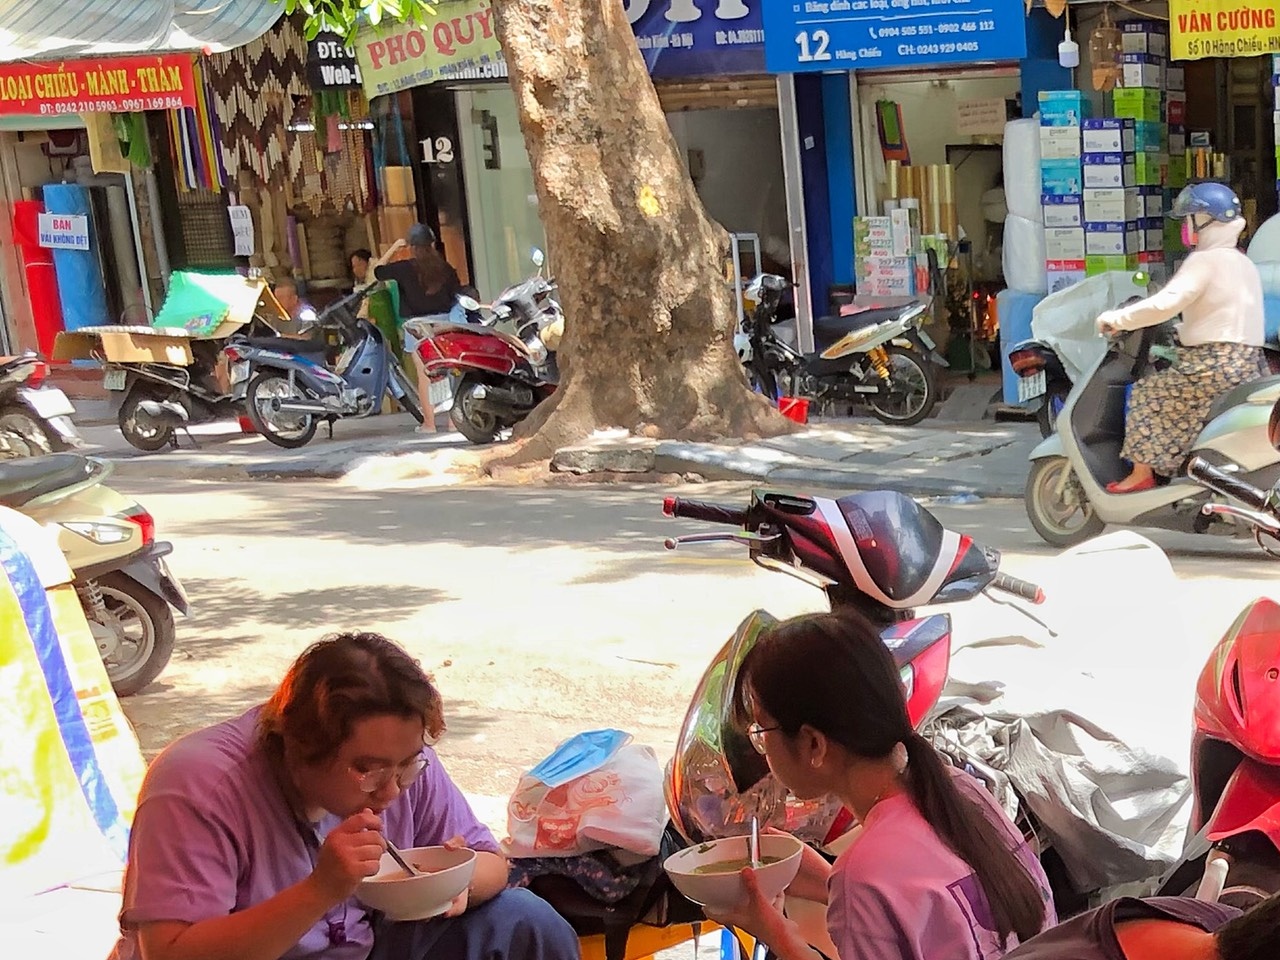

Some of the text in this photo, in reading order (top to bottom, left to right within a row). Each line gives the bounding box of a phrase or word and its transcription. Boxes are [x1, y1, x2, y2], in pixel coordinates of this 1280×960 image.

[1217, 5, 1276, 32] CƯỜNG
[795, 30, 832, 62] 12
[1201, 40, 1211, 54] 10
[0, 75, 34, 106] LOẠI
[34, 62, 79, 99] CHIẾU
[86, 64, 130, 97] MÀNH
[137, 57, 183, 93] THẢM
[55, 102, 77, 113] 0242
[78, 101, 94, 112] 210
[95, 100, 117, 111] 5963
[122, 98, 144, 110] 0967
[165, 96, 183, 107] 864
[418, 136, 454, 163] 12
